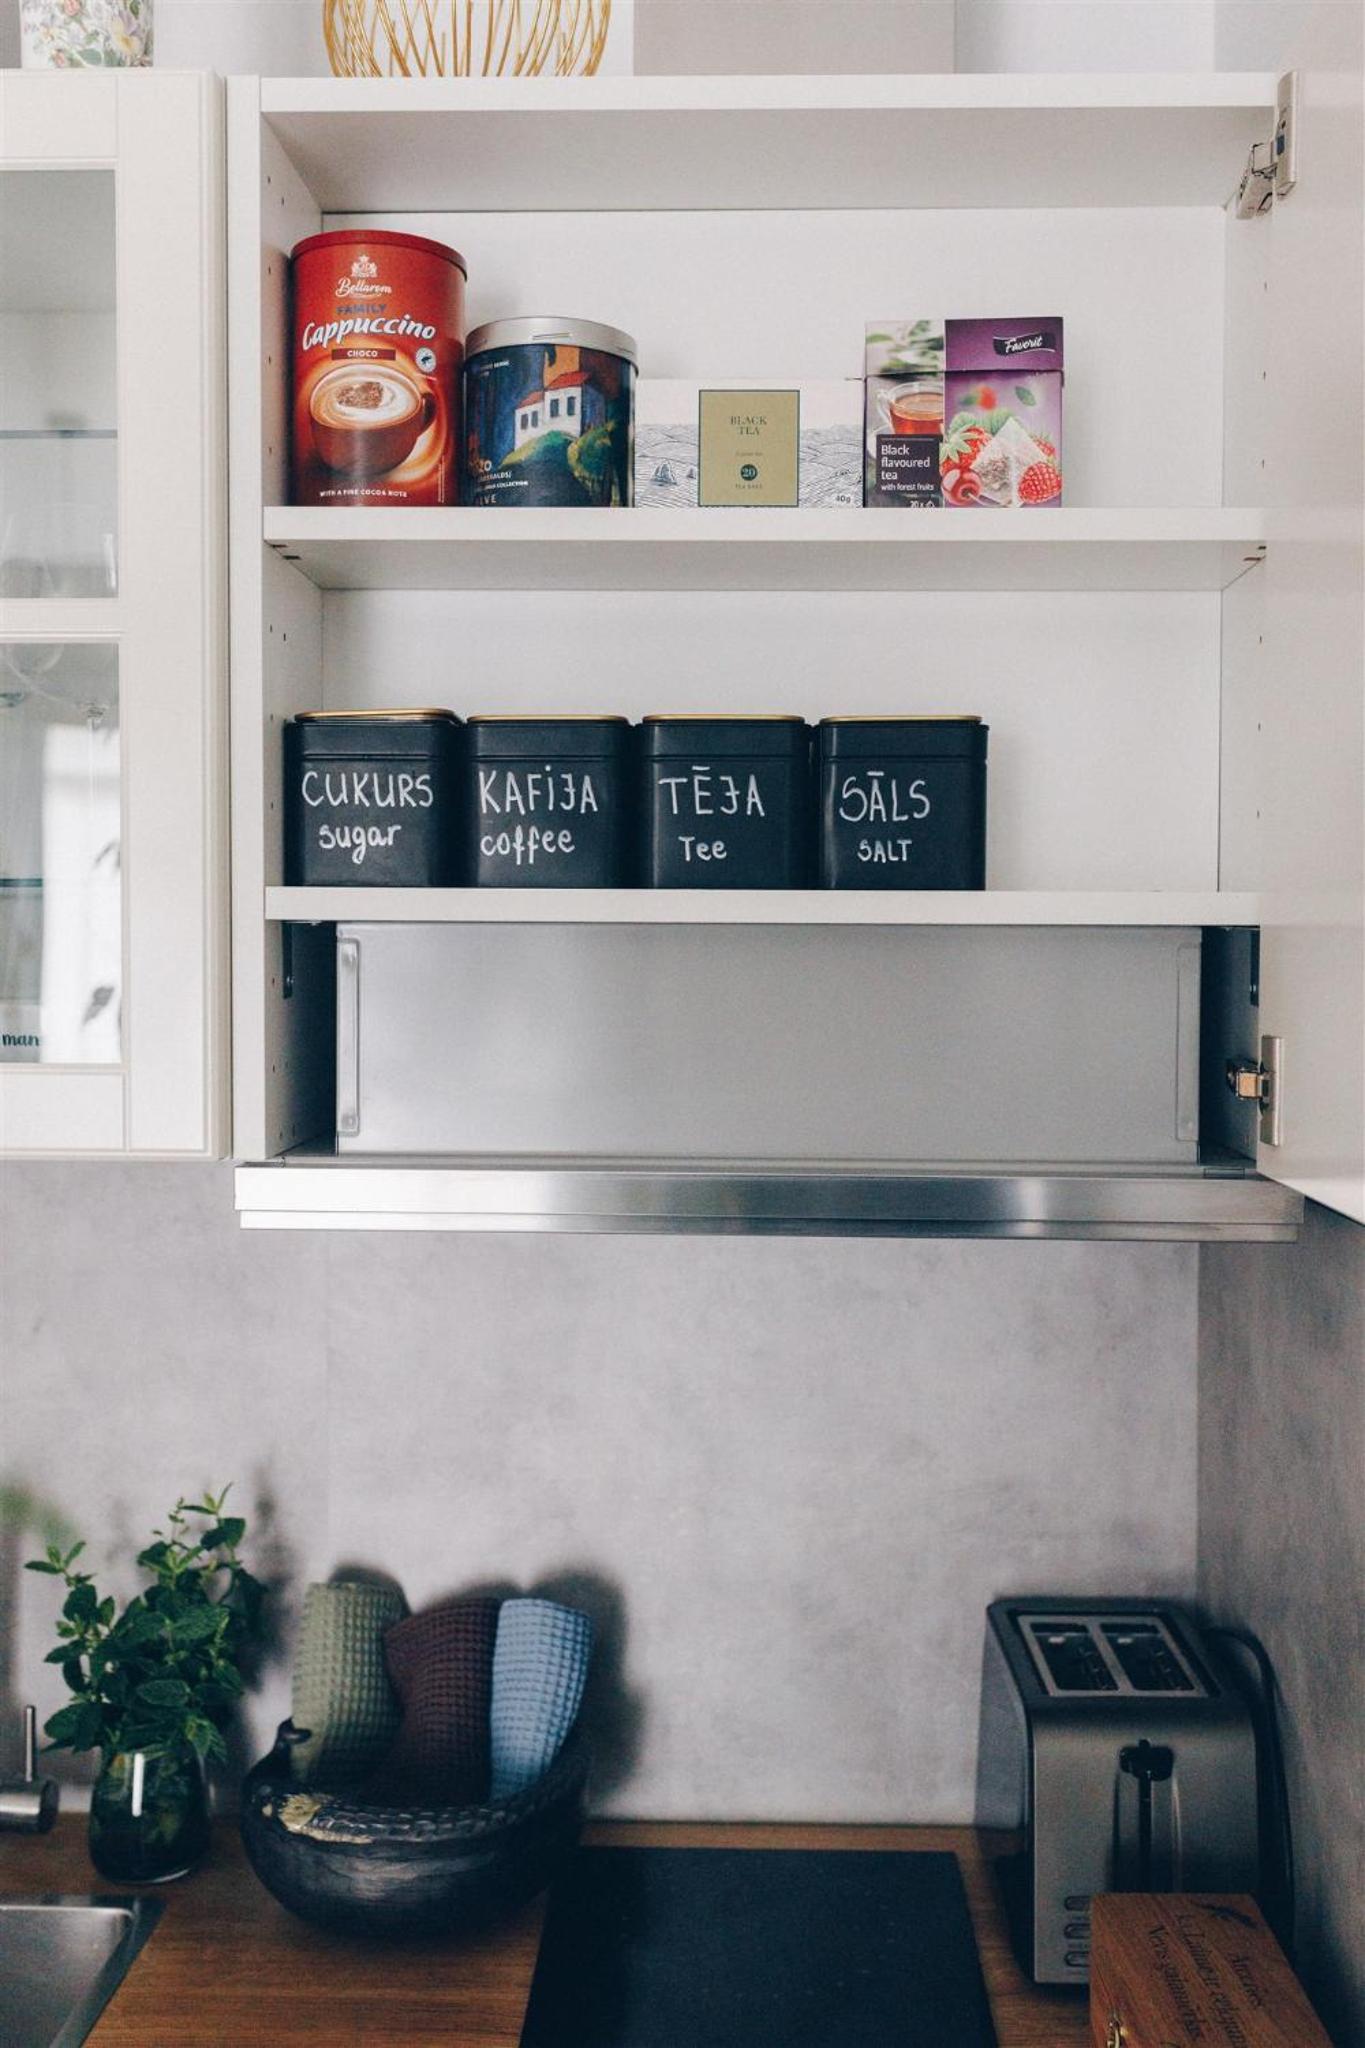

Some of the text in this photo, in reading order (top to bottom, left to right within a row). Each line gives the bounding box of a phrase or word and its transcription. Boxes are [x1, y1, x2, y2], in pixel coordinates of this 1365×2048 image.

[336, 277, 392, 298] Bellarom
[336, 304, 387, 314] FAMILY
[303, 314, 436, 350] Cappuccino
[1005, 335, 1043, 353] Favorit
[730, 416, 767, 425] BLACK
[738, 426, 760, 435] TEA
[881, 444, 910, 456] Black
[881, 456, 930, 468] flavoured
[881, 469, 898, 481] tea
[881, 482, 935, 491] with forest fruits
[301, 771, 434, 808] CUKURS
[658, 766, 765, 817] TĒJA
[839, 771, 931, 822] SĀLS
[318, 823, 402, 864] sugar
[480, 825, 575, 866] coffee
[678, 836, 727, 862] Tee
[857, 839, 912, 863] SALT
